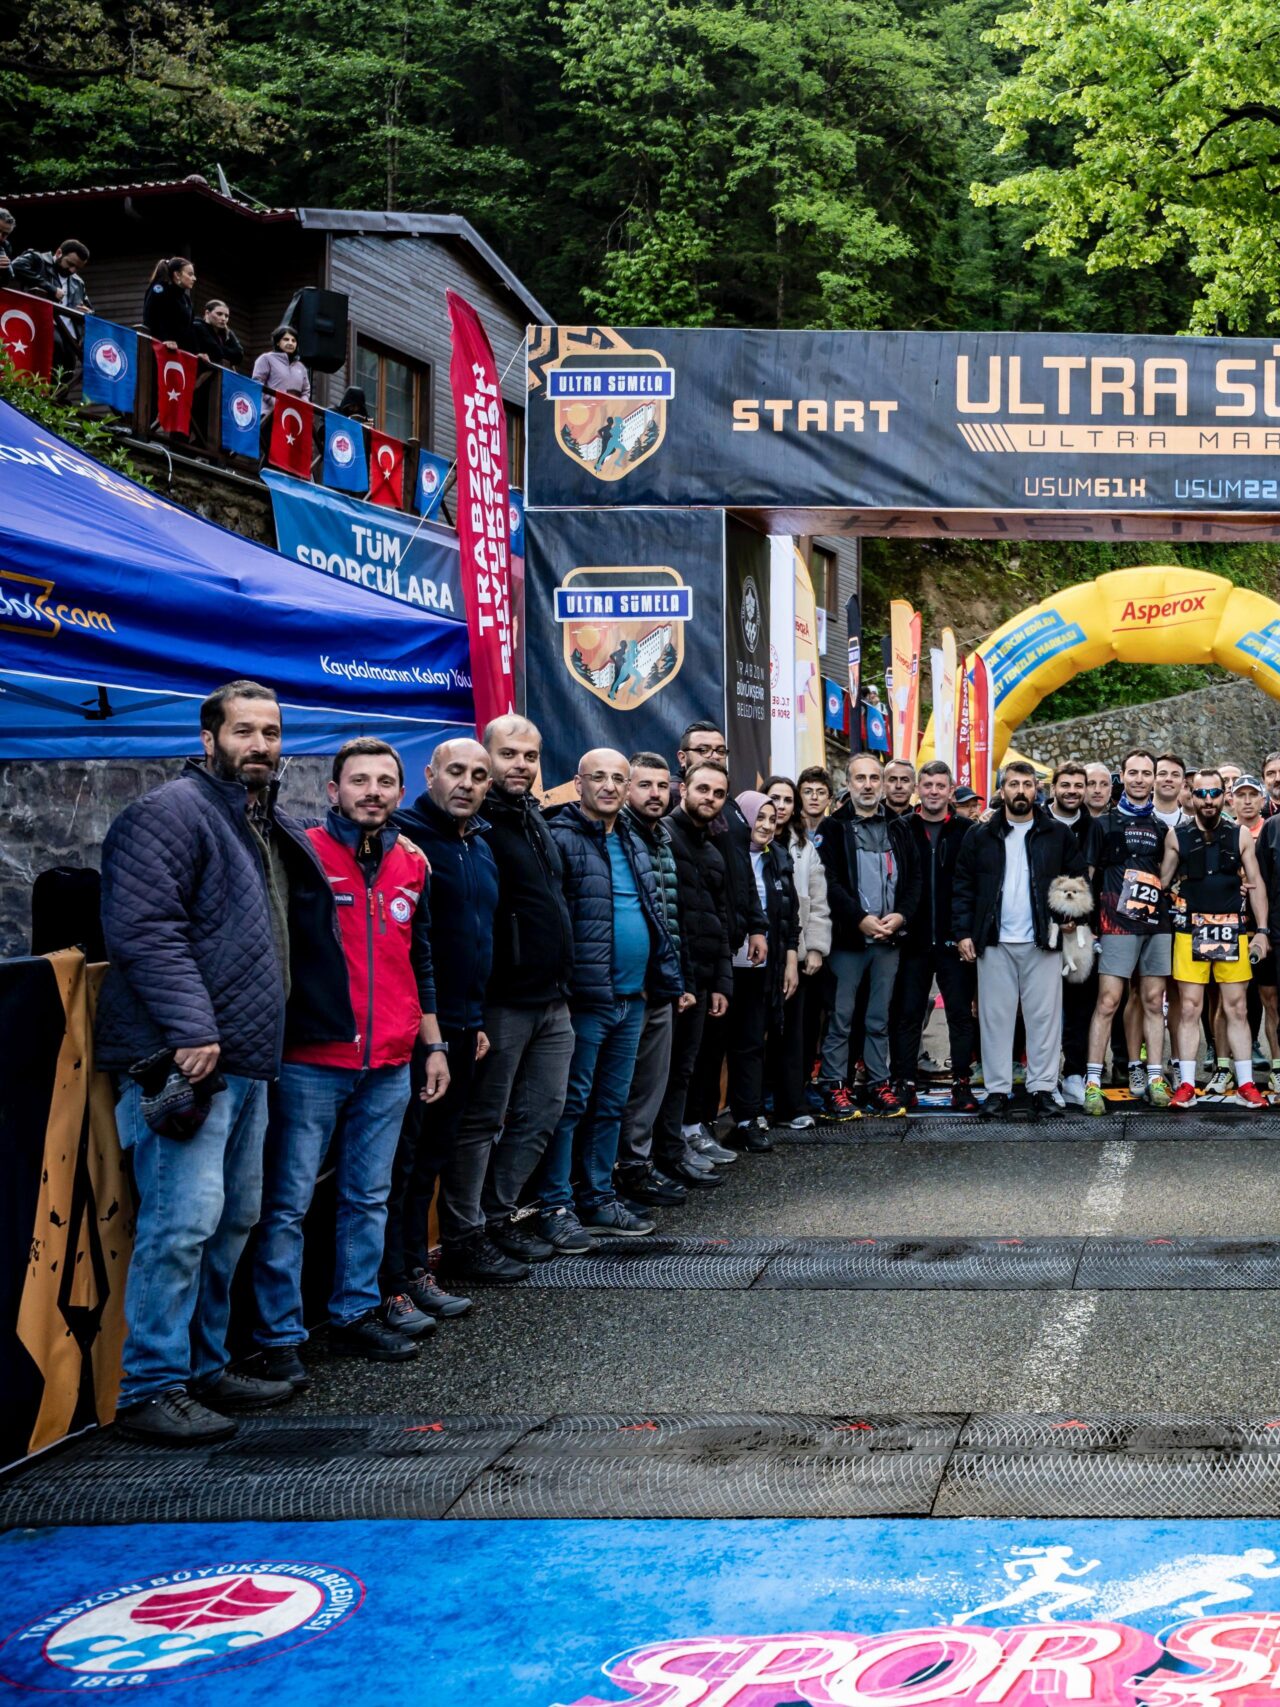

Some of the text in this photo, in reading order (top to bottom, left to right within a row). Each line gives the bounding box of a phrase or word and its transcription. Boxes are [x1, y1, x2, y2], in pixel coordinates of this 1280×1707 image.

[558, 374, 664, 393] ULTRA SÜMELA
[955, 355, 1188, 417] ULTRA
[732, 399, 898, 433] START
[1027, 429, 1168, 450] ULTRA
[1024, 476, 1146, 498] USUM61K
[464, 394, 494, 637] TRABZON
[351, 524, 400, 565] TÜM
[566, 593, 680, 613] ULTRA SÜMELA
[1121, 595, 1206, 624] Asperox
[320, 655, 414, 682] Kaydolmanın
[412, 667, 450, 690] Kolay
[1130, 883, 1159, 903] 129
[1200, 926, 1233, 940] 118
[20, 1563, 355, 1642] TRABZON BÜYÜKŞEHİR BELEDİYESİ
[590, 1622, 1122, 1707] SPOR
[71, 1673, 149, 1688] 1868
